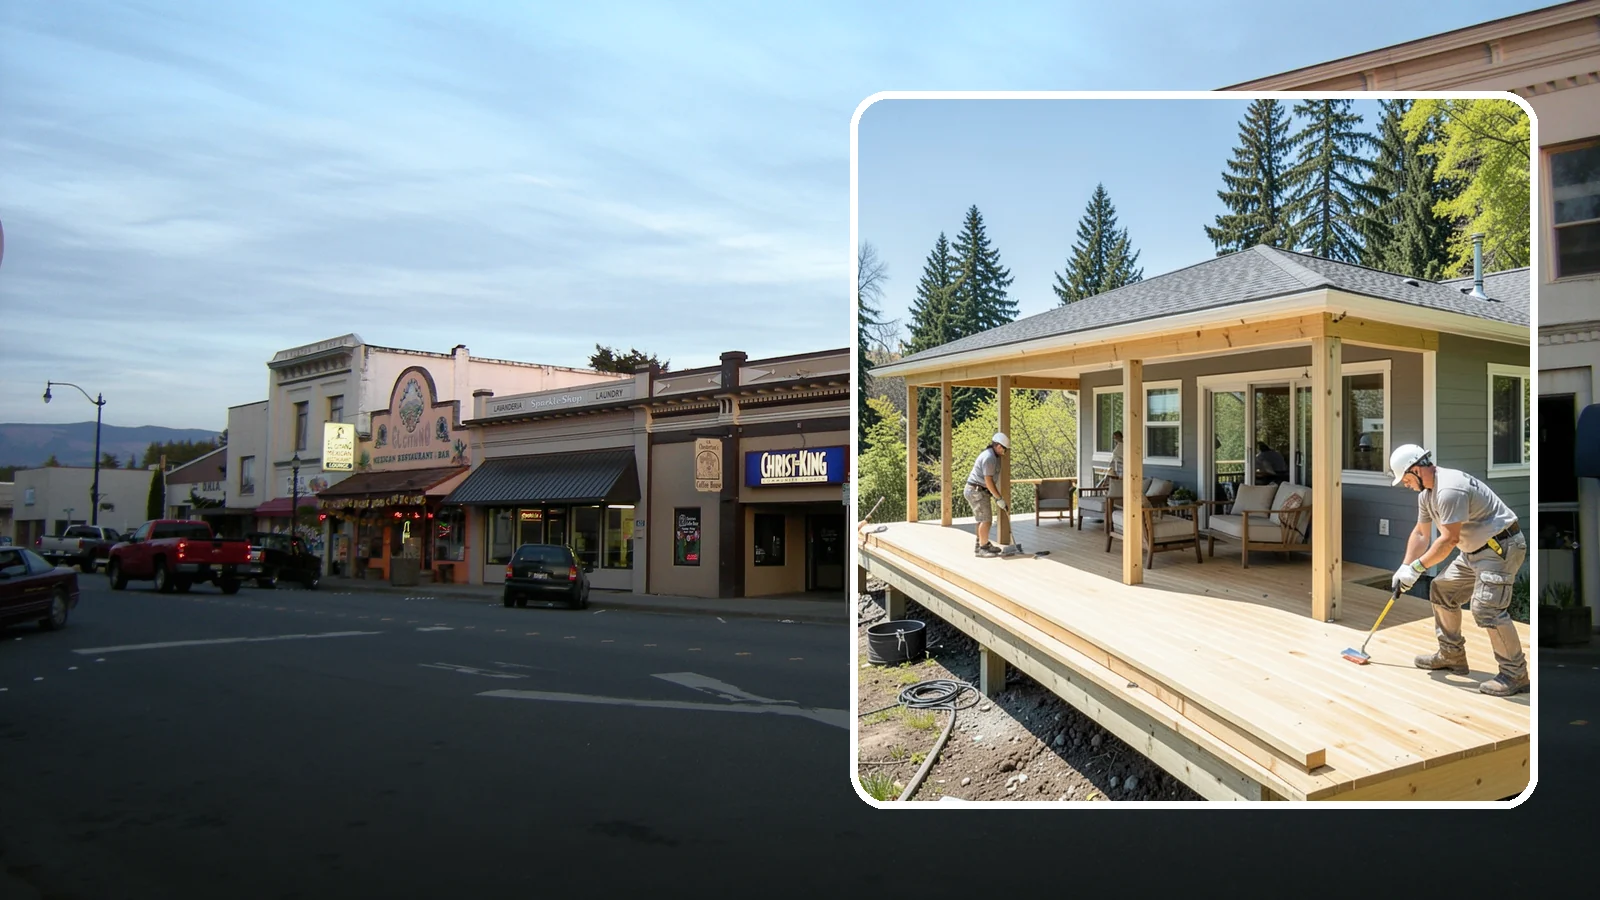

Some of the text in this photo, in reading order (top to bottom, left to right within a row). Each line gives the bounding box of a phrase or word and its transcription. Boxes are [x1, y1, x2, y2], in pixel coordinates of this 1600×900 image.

[531, 394, 582, 408] Sparkle Shop
[595, 389, 623, 400] LAUNDRY
[493, 402, 523, 413] LAVANDERIA
[373, 450, 450, 464] MEXICAN RESTAURANT BAR
[761, 450, 827, 478] CHRIST KING
